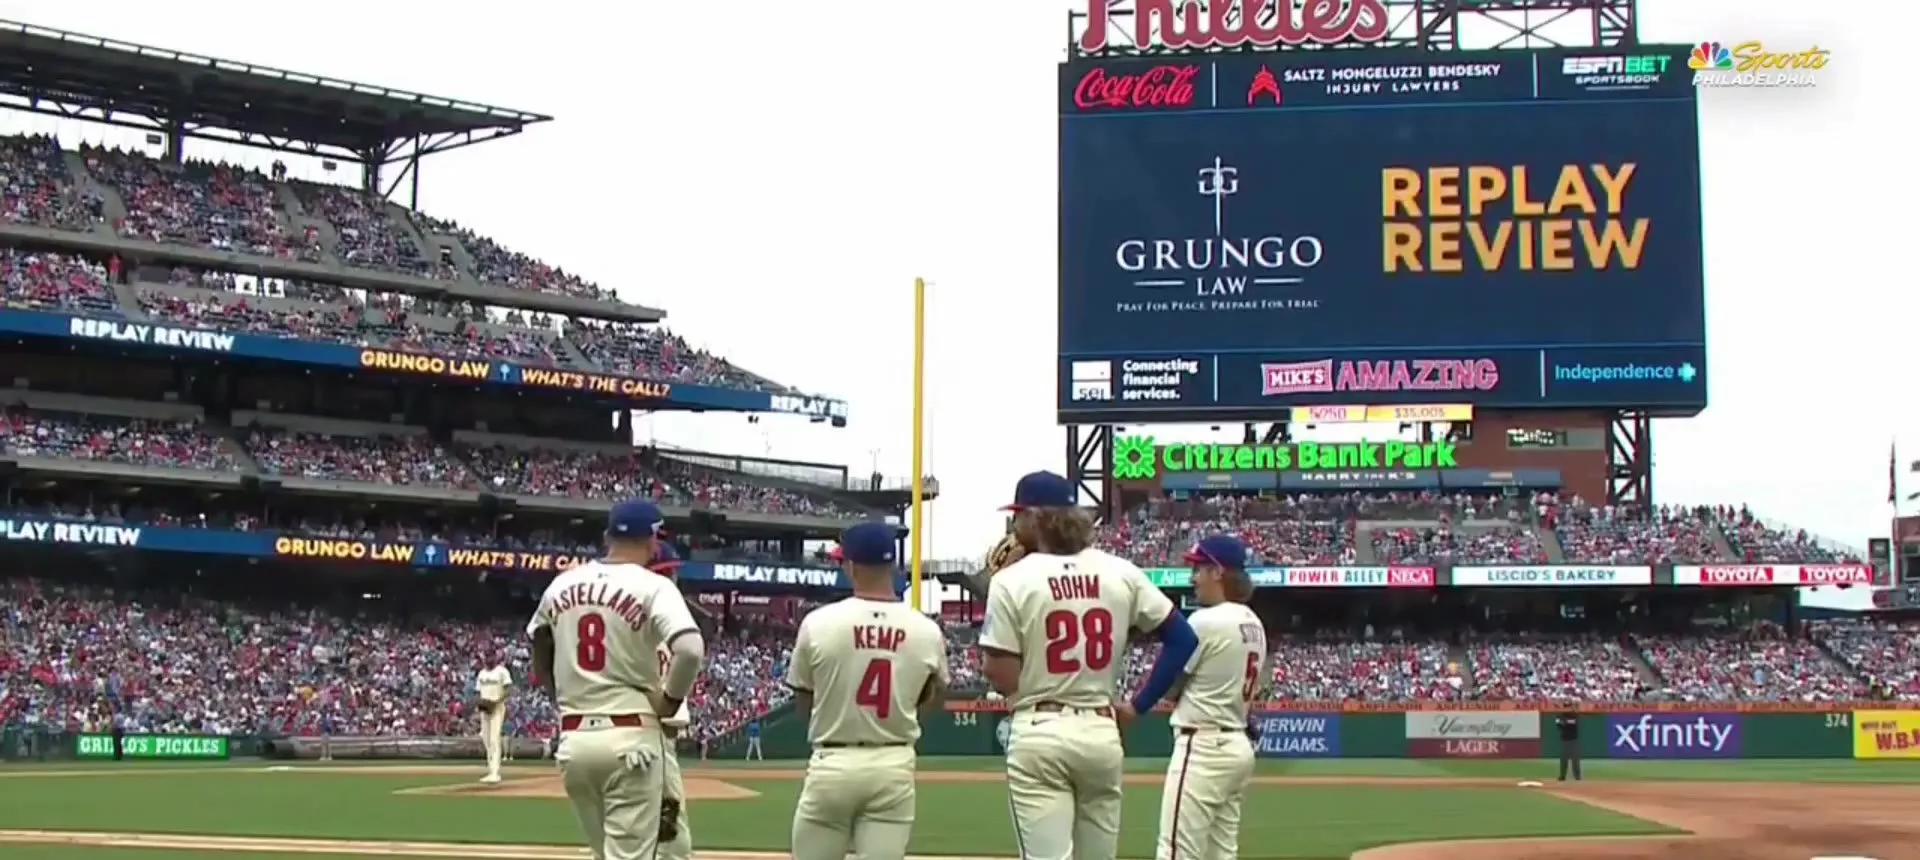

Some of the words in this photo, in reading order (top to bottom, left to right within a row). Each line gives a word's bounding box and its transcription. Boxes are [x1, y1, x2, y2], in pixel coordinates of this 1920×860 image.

[1284, 68, 1325, 82] SALTZ
[1332, 66, 1422, 81] MONGELUZZI
[1429, 64, 1501, 78] BENDESKY
[1575, 75, 1660, 85] SPORTSBOOK
[1326, 82, 1381, 95] INJURY
[1391, 80, 1460, 93] LAWYERS
[1382, 163, 1637, 217] REPLAY
[1116, 236, 1323, 271] GRUNGO
[1383, 218, 1650, 273] REVIEW
[1196, 276, 1248, 297] LAW
[70, 317, 147, 342] REPLAY
[154, 325, 235, 352] REVIEW
[361, 350, 444, 375] GRUNGO
[449, 360, 491, 379] LAW
[1122, 358, 1198, 374] Connecting
[1336, 359, 1499, 391] AMAZING
[1555, 362, 1674, 383] Independence
[520, 367, 585, 390] WHAT'S
[587, 374, 619, 394] THE
[621, 379, 671, 398] CALL?
[1123, 372, 1180, 386] financial
[1271, 368, 1325, 387] MIKE'S
[1122, 386, 1181, 400] services.
[771, 395, 827, 414] REPLAY
[1162, 441, 1290, 470] Citizens
[1298, 436, 1379, 470] Bank
[1385, 436, 1456, 468] Park
[54, 522, 141, 546] REVIEW
[276, 536, 365, 559] GRUNGO
[371, 541, 414, 562] LAW
[448, 548, 517, 568] WHAT'S
[518, 552, 552, 570] THE
[714, 563, 775, 582] REPLAY
[777, 567, 838, 586] REVIEW
[1289, 568, 1339, 584] POWER
[1344, 568, 1386, 584] ALLEY
[1389, 567, 1431, 585] NECA
[1487, 569, 1552, 582] LISCIO'S
[1555, 569, 1616, 582] BAKERY
[1702, 567, 1769, 583] TOYOTA
[1803, 567, 1868, 582] TOYOTA
[1048, 574, 1100, 601] BOHM
[577, 612, 606, 672] 8
[854, 625, 906, 652] KEMP
[1045, 607, 1113, 675] 28
[856, 658, 892, 719] 4
[954, 711, 977, 726] 334
[1259, 716, 1326, 734] HERWIN
[1825, 713, 1849, 728] 374
[1614, 714, 1734, 752] xfinity
[155, 736, 220, 754] PICKLES
[1444, 739, 1500, 754] LAGER
